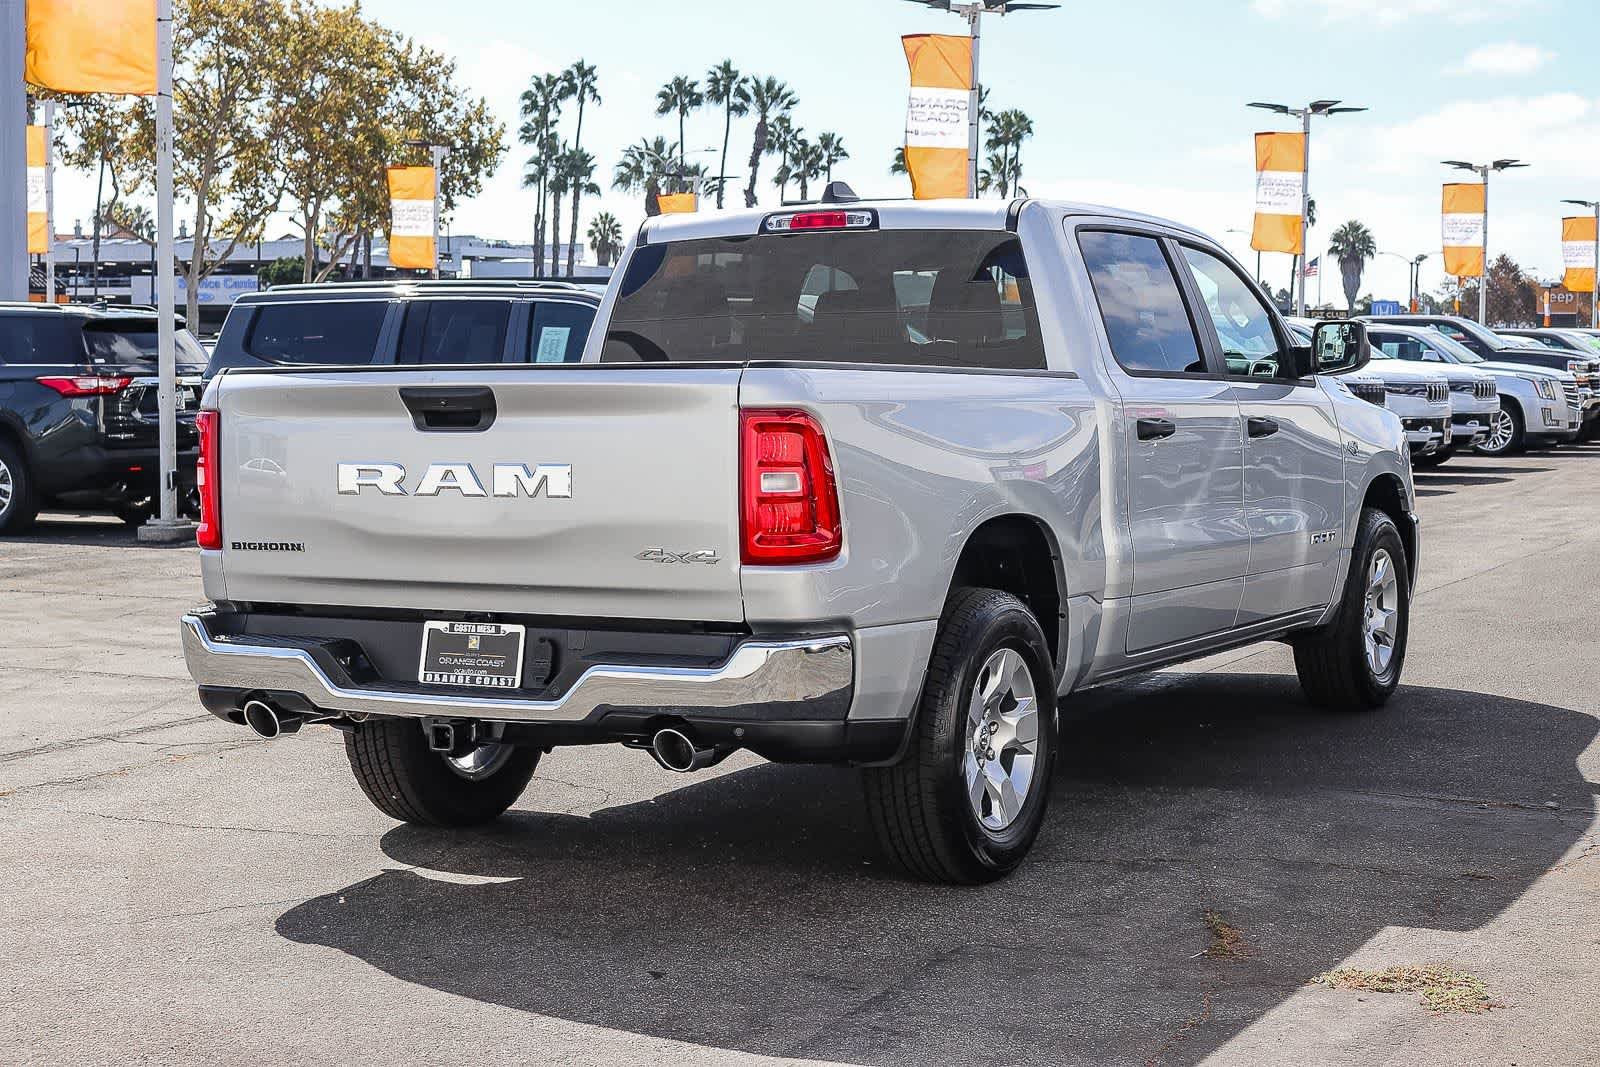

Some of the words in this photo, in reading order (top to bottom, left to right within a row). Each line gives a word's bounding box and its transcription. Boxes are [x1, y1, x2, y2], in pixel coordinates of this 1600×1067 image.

[1540, 293, 1574, 304] eep
[336, 461, 573, 498] RAM
[231, 541, 306, 553] BIGHORN
[454, 623, 476, 633] COSTA
[476, 624, 496, 633] MESA
[425, 673, 471, 684] ORANGE
[475, 676, 514, 687] COAST
